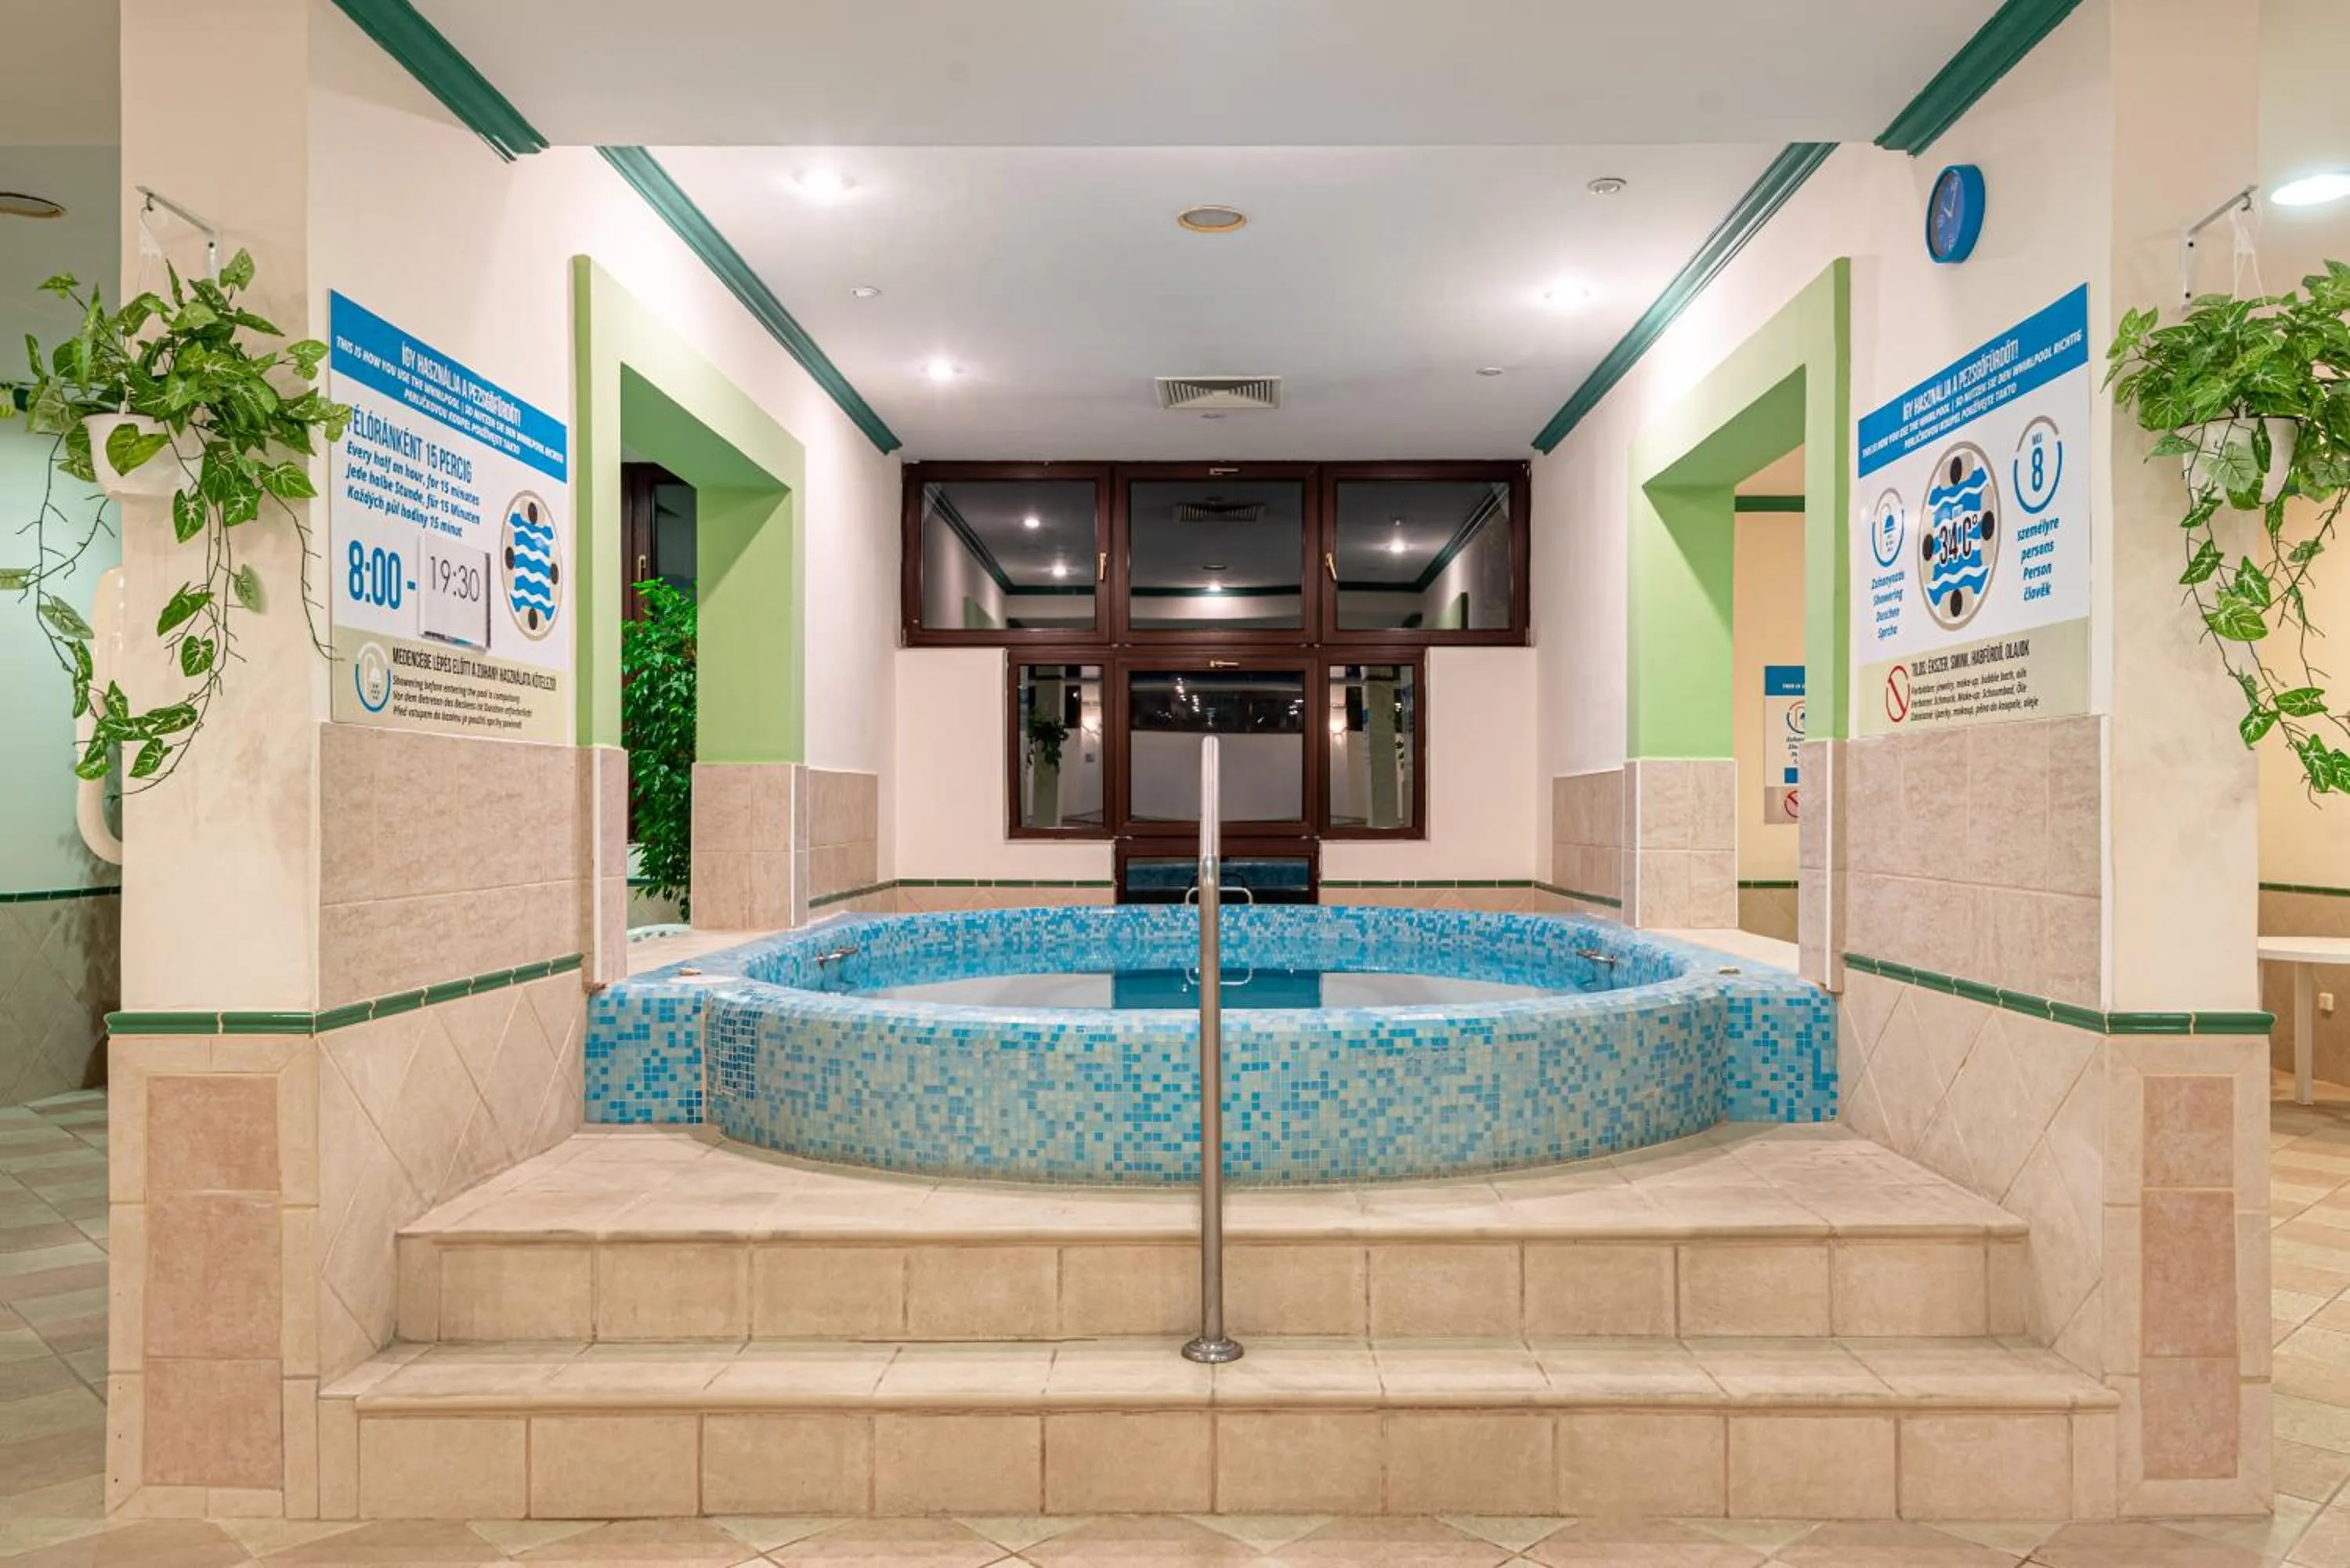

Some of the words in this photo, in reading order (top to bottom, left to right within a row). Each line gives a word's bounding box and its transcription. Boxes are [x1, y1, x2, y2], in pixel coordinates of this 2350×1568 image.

[347, 439, 371, 466] Every
[374, 450, 391, 474] half
[392, 463, 403, 475] an
[405, 464, 425, 486] hour,
[426, 472, 438, 493] for
[441, 479, 449, 493] 15
[450, 483, 479, 506] minutes
[426, 441, 437, 469] 15
[439, 447, 472, 484] PERCIG
[2031, 444, 2043, 493] 8
[345, 460, 367, 486] Jede
[369, 469, 392, 492] halbe
[426, 492, 438, 513] für
[450, 501, 479, 525] Minuten
[347, 482, 384, 514] Každých
[401, 504, 428, 529] hodiny
[430, 514, 439, 529] 15
[440, 518, 462, 537] minut
[1939, 520, 1958, 565] 34
[2016, 515, 2059, 544] személyre
[2020, 540, 2054, 564] persons
[349, 537, 401, 610] 8:00
[430, 555, 479, 603] 19:30
[2023, 560, 2052, 580] Person
